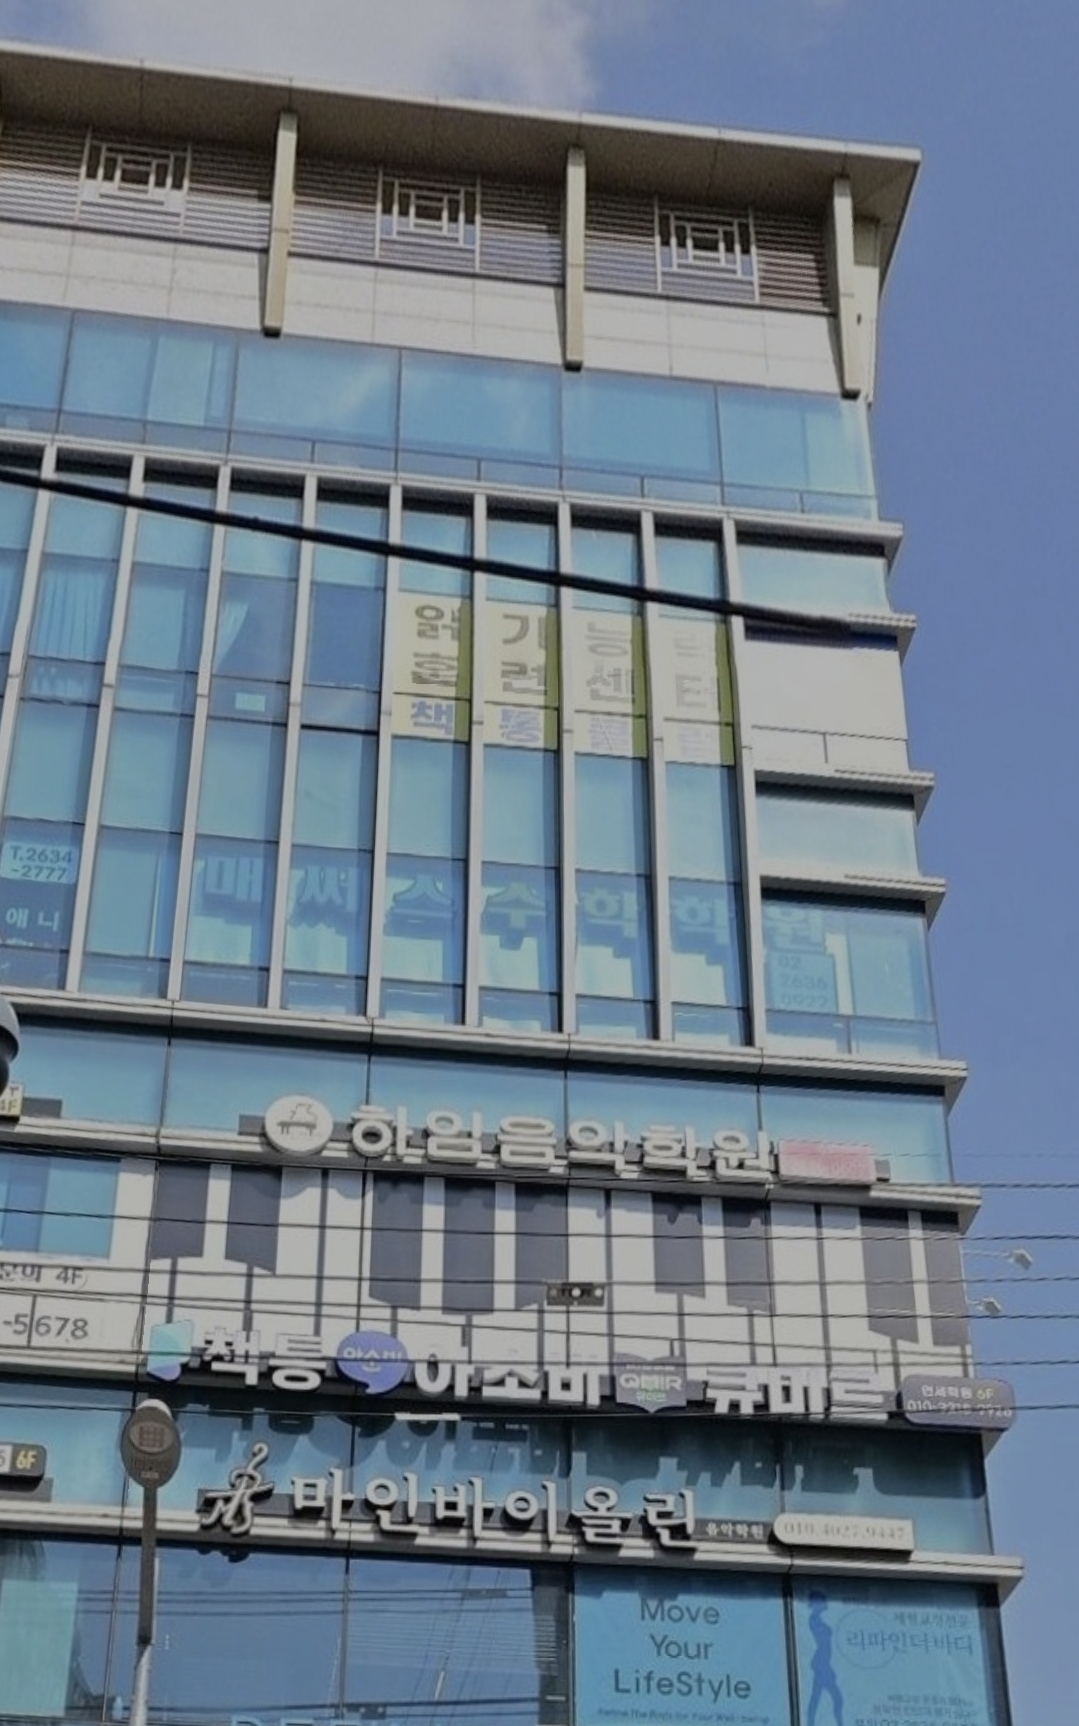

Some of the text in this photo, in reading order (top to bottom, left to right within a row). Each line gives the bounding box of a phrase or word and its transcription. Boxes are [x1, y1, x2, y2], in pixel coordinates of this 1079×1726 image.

[350, 1105, 772, 1182] 하임음악학원
[15, 1450, 38, 1471] 6F
[293, 1467, 697, 1548] 마인바이올린
[640, 1599, 720, 1625] Move
[650, 1633, 714, 1660] Your
[613, 1668, 751, 1703] LifeStyle
